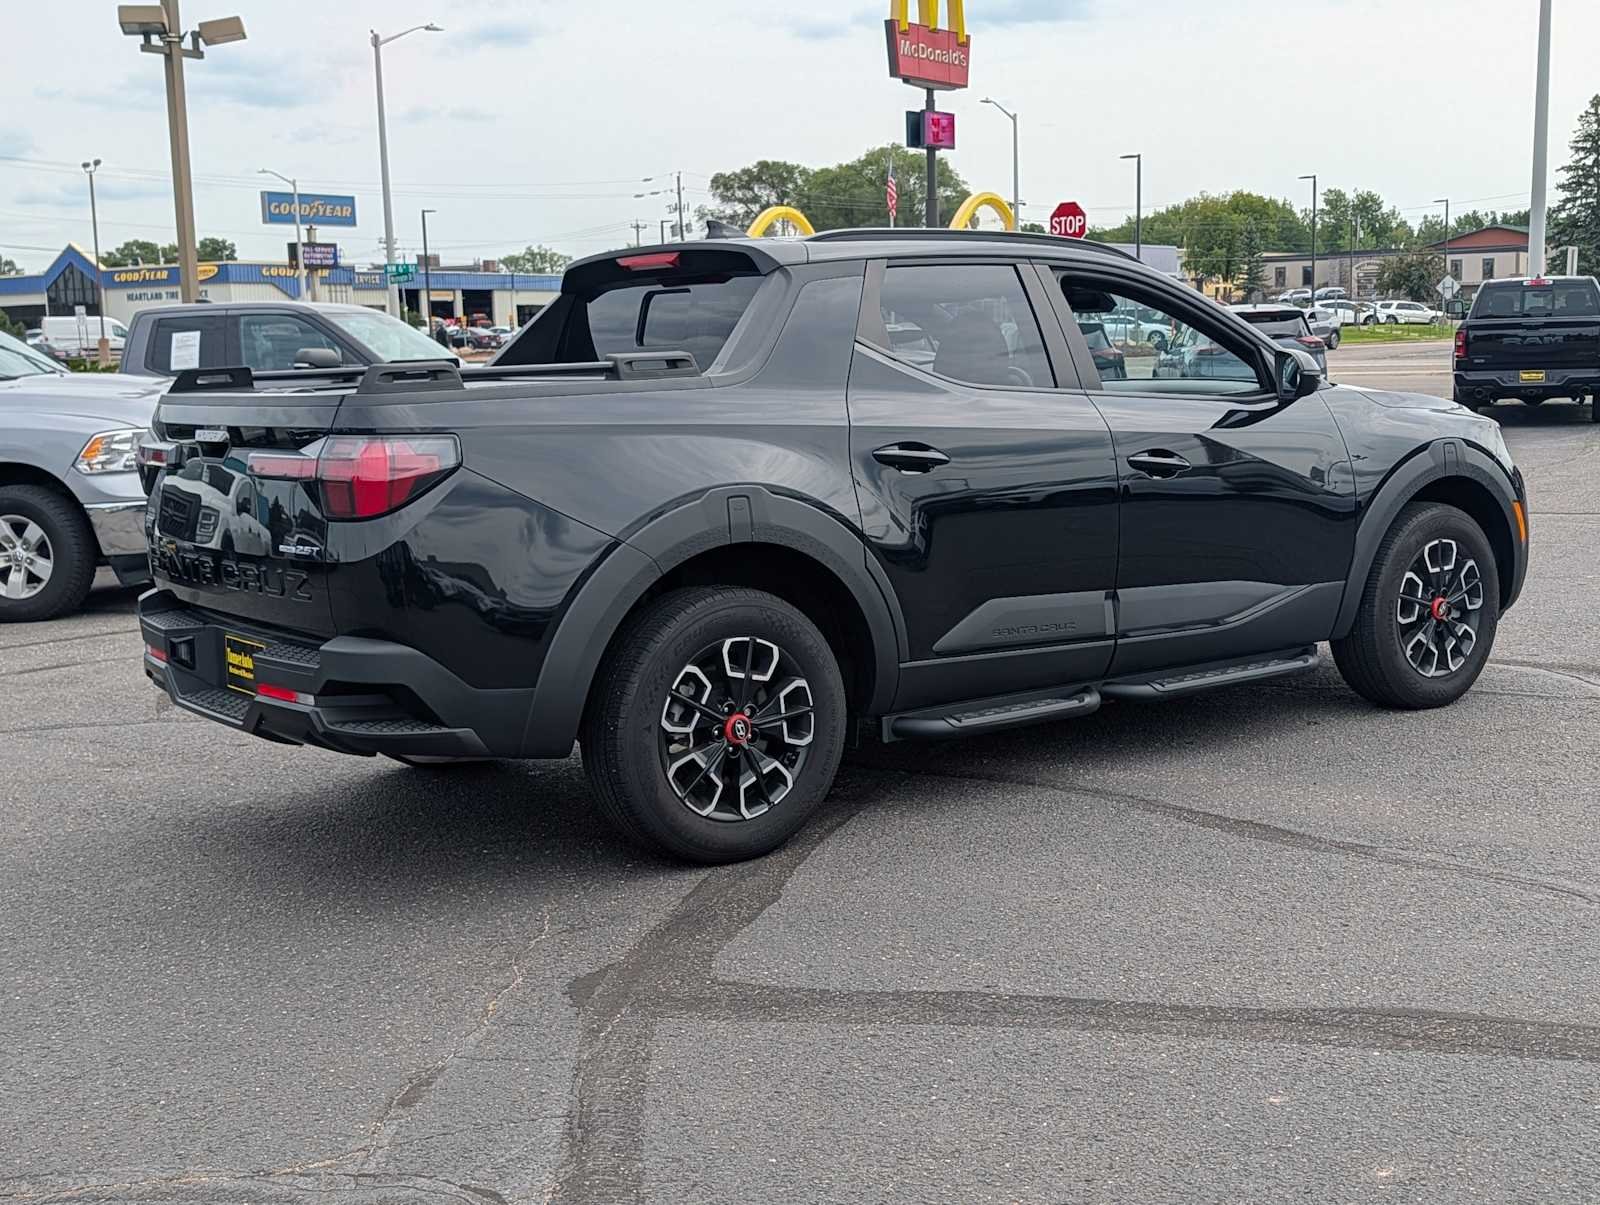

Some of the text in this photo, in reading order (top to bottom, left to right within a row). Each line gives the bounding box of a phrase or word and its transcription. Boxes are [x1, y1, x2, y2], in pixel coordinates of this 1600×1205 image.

[899, 39, 967, 66] McDonald's
[270, 200, 352, 218] GOODYEAR
[1052, 215, 1084, 234] STOP
[114, 271, 168, 282] GOODYEAR
[126, 291, 179, 301] HEARTLAND TIRE
[1502, 337, 1564, 345] RAM
[221, 559, 313, 603] CRUZ
[992, 622, 1077, 637] SANTA CRUZ
